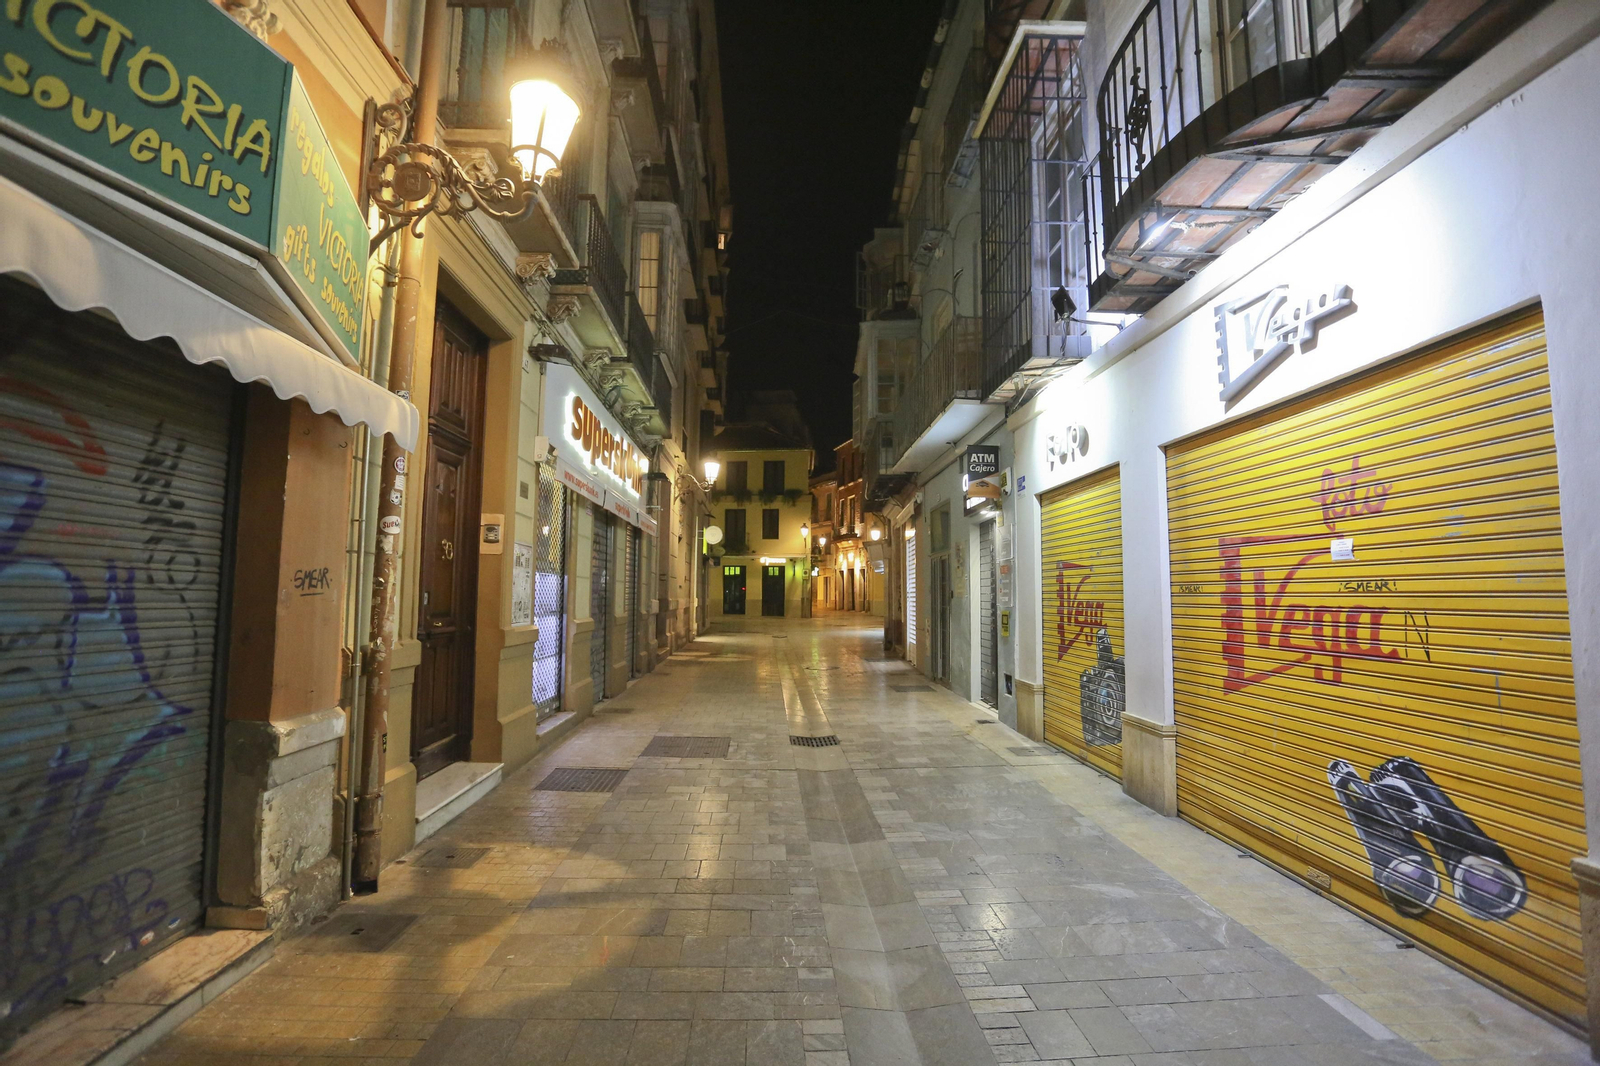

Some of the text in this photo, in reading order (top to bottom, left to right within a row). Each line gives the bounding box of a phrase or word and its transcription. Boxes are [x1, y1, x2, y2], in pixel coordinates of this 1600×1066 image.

[0, 52, 253, 215] souvenirs
[290, 104, 335, 208] regalos
[284, 223, 358, 345] gifts souvenirs
[318, 201, 365, 313] VICTORIA
[1242, 284, 1355, 354] Vega
[969, 464, 996, 474] Cajero
[970, 453, 995, 463] ATM
[1309, 455, 1394, 533] foto
[1253, 550, 1403, 686] Vega
